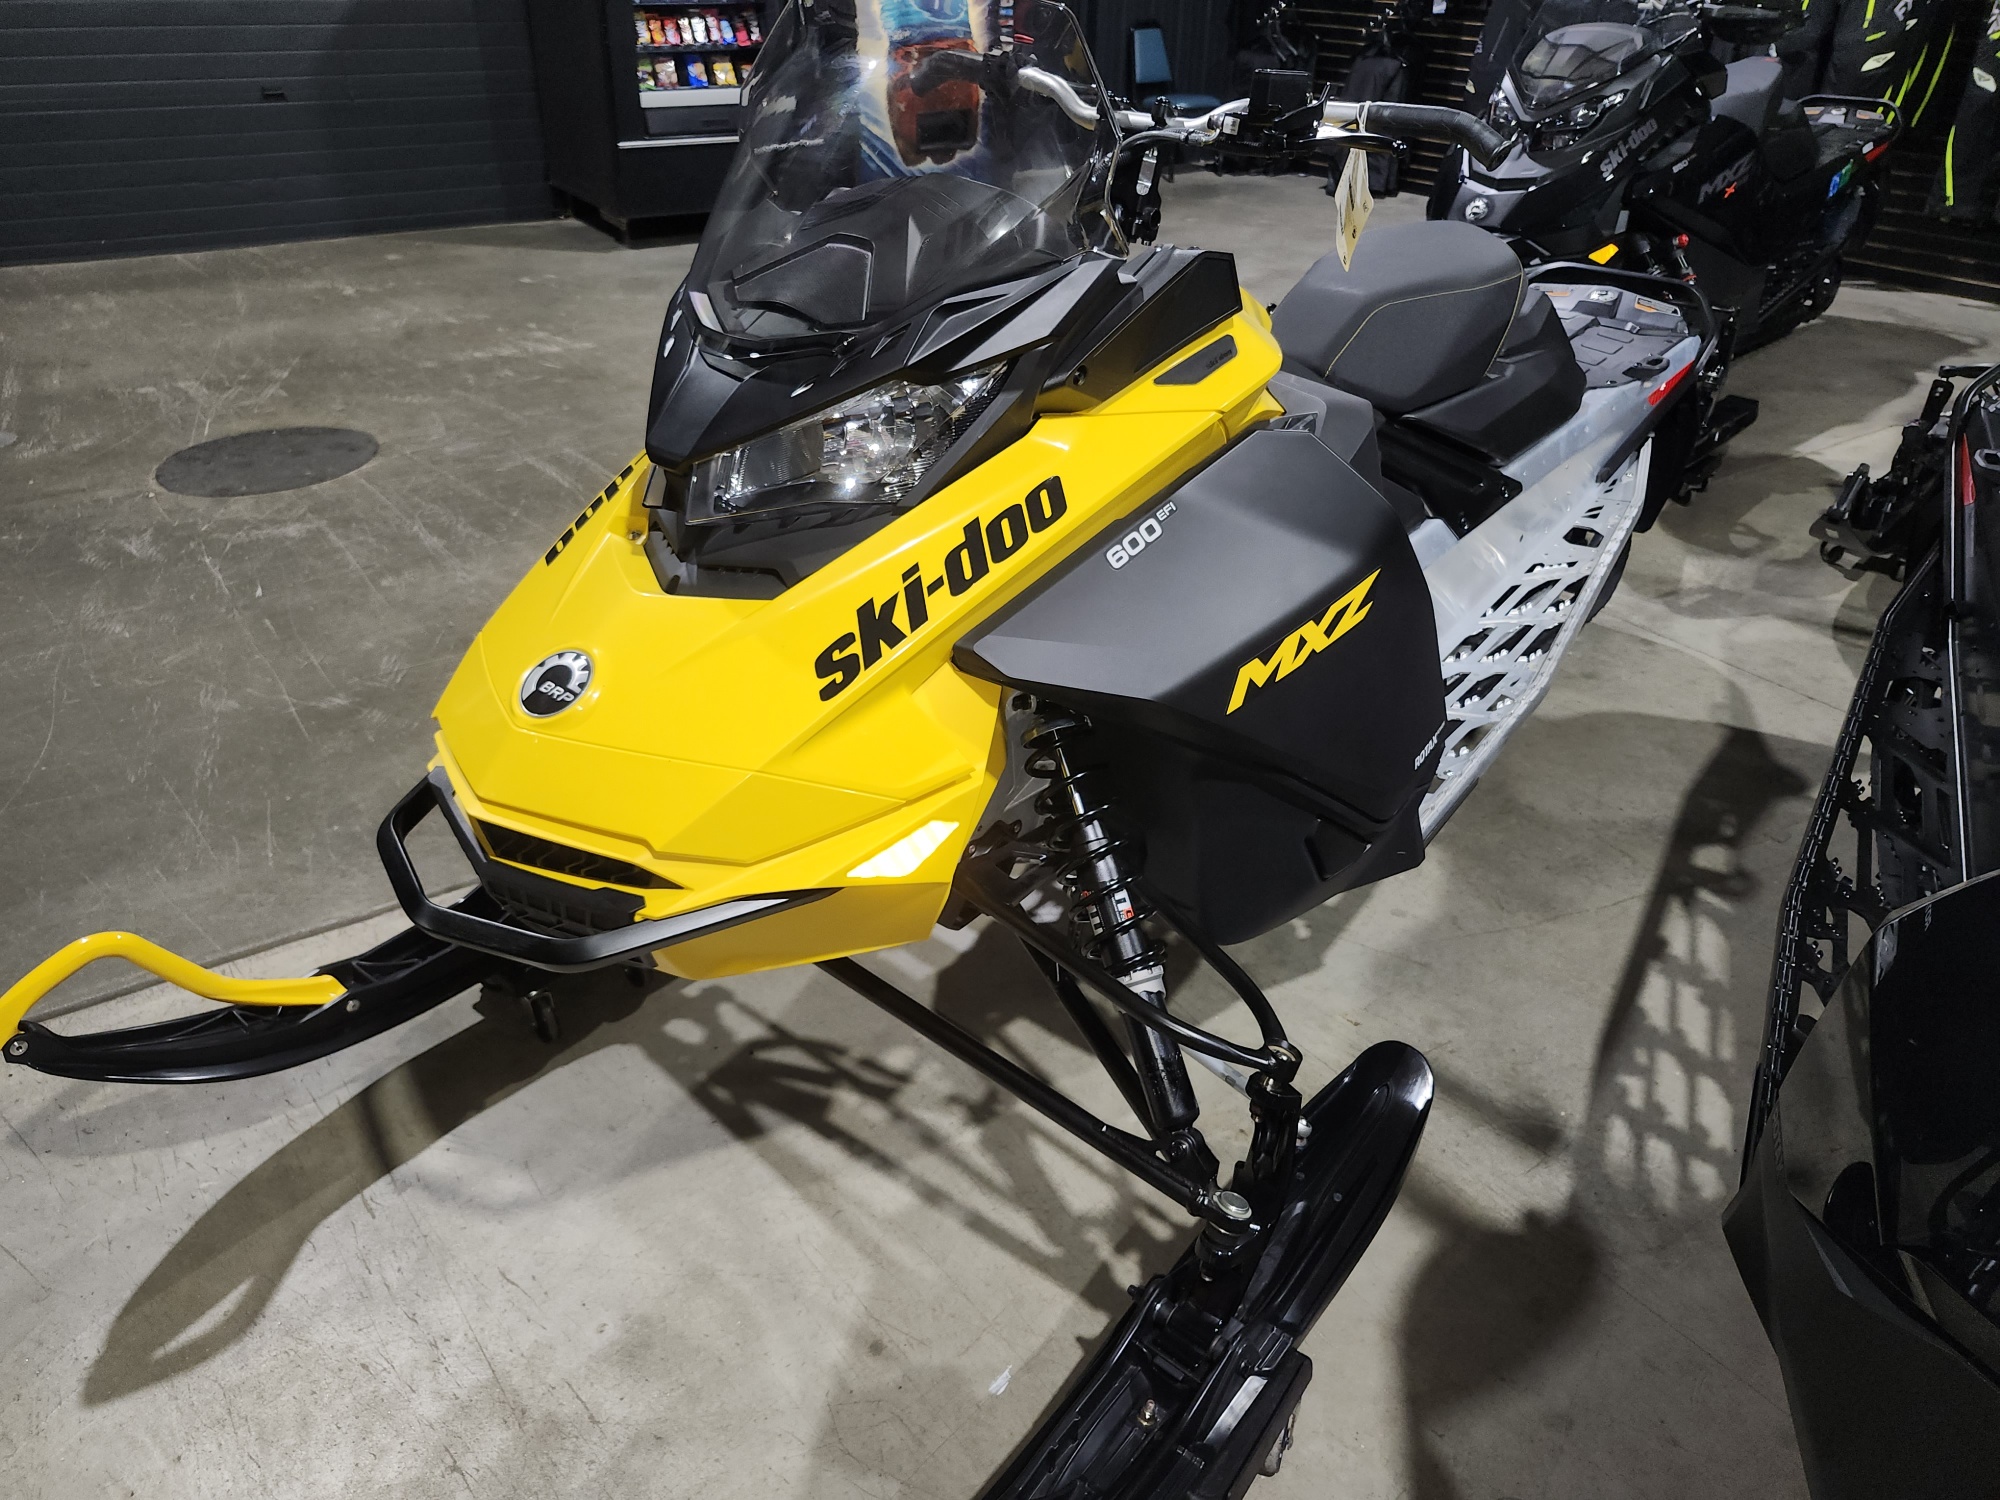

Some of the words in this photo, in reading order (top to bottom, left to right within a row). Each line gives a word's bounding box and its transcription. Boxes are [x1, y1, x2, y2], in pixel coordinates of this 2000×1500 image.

[1600, 118, 1658, 180] ski-doo
[1106, 517, 1163, 569] 600
[1155, 501, 1177, 521] EFI
[814, 475, 1068, 702] ski-doo
[1226, 567, 1382, 716] MXZ
[538, 680, 575, 702] BRP
[1414, 735, 1437, 770] ROTAX
